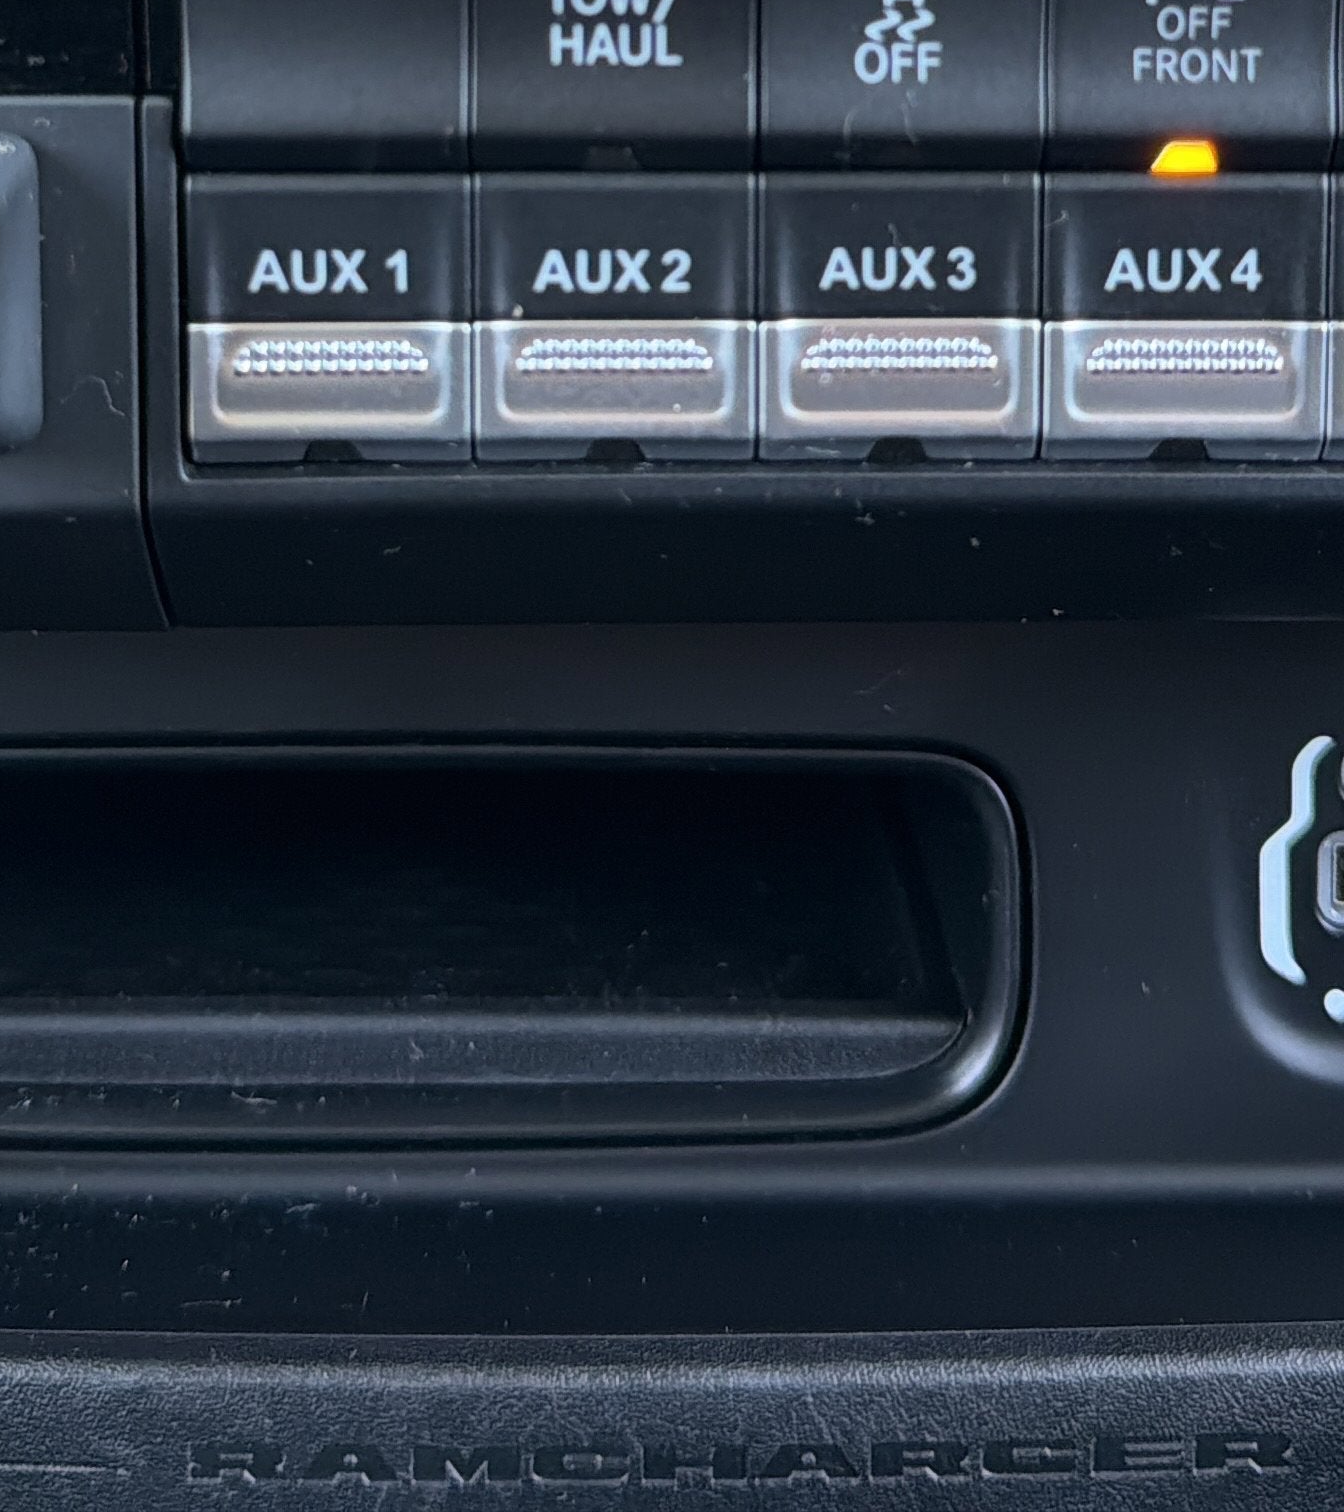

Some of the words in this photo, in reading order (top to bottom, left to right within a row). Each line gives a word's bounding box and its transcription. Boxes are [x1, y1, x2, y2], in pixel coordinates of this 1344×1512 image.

[1156, 5, 1232, 41] OFF
[549, 25, 683, 67] HAUL
[854, 43, 942, 85] OFF
[1132, 47, 1262, 84] FRONT
[248, 248, 368, 294] AUX
[385, 248, 408, 293] 1
[532, 248, 651, 294] AUX
[661, 248, 692, 294] 2
[818, 246, 936, 291] AUX
[947, 246, 977, 291] 3
[1103, 248, 1222, 293] AUX
[1230, 248, 1263, 292] 4
[189, 1430, 1296, 1482] RAMCHARGER
